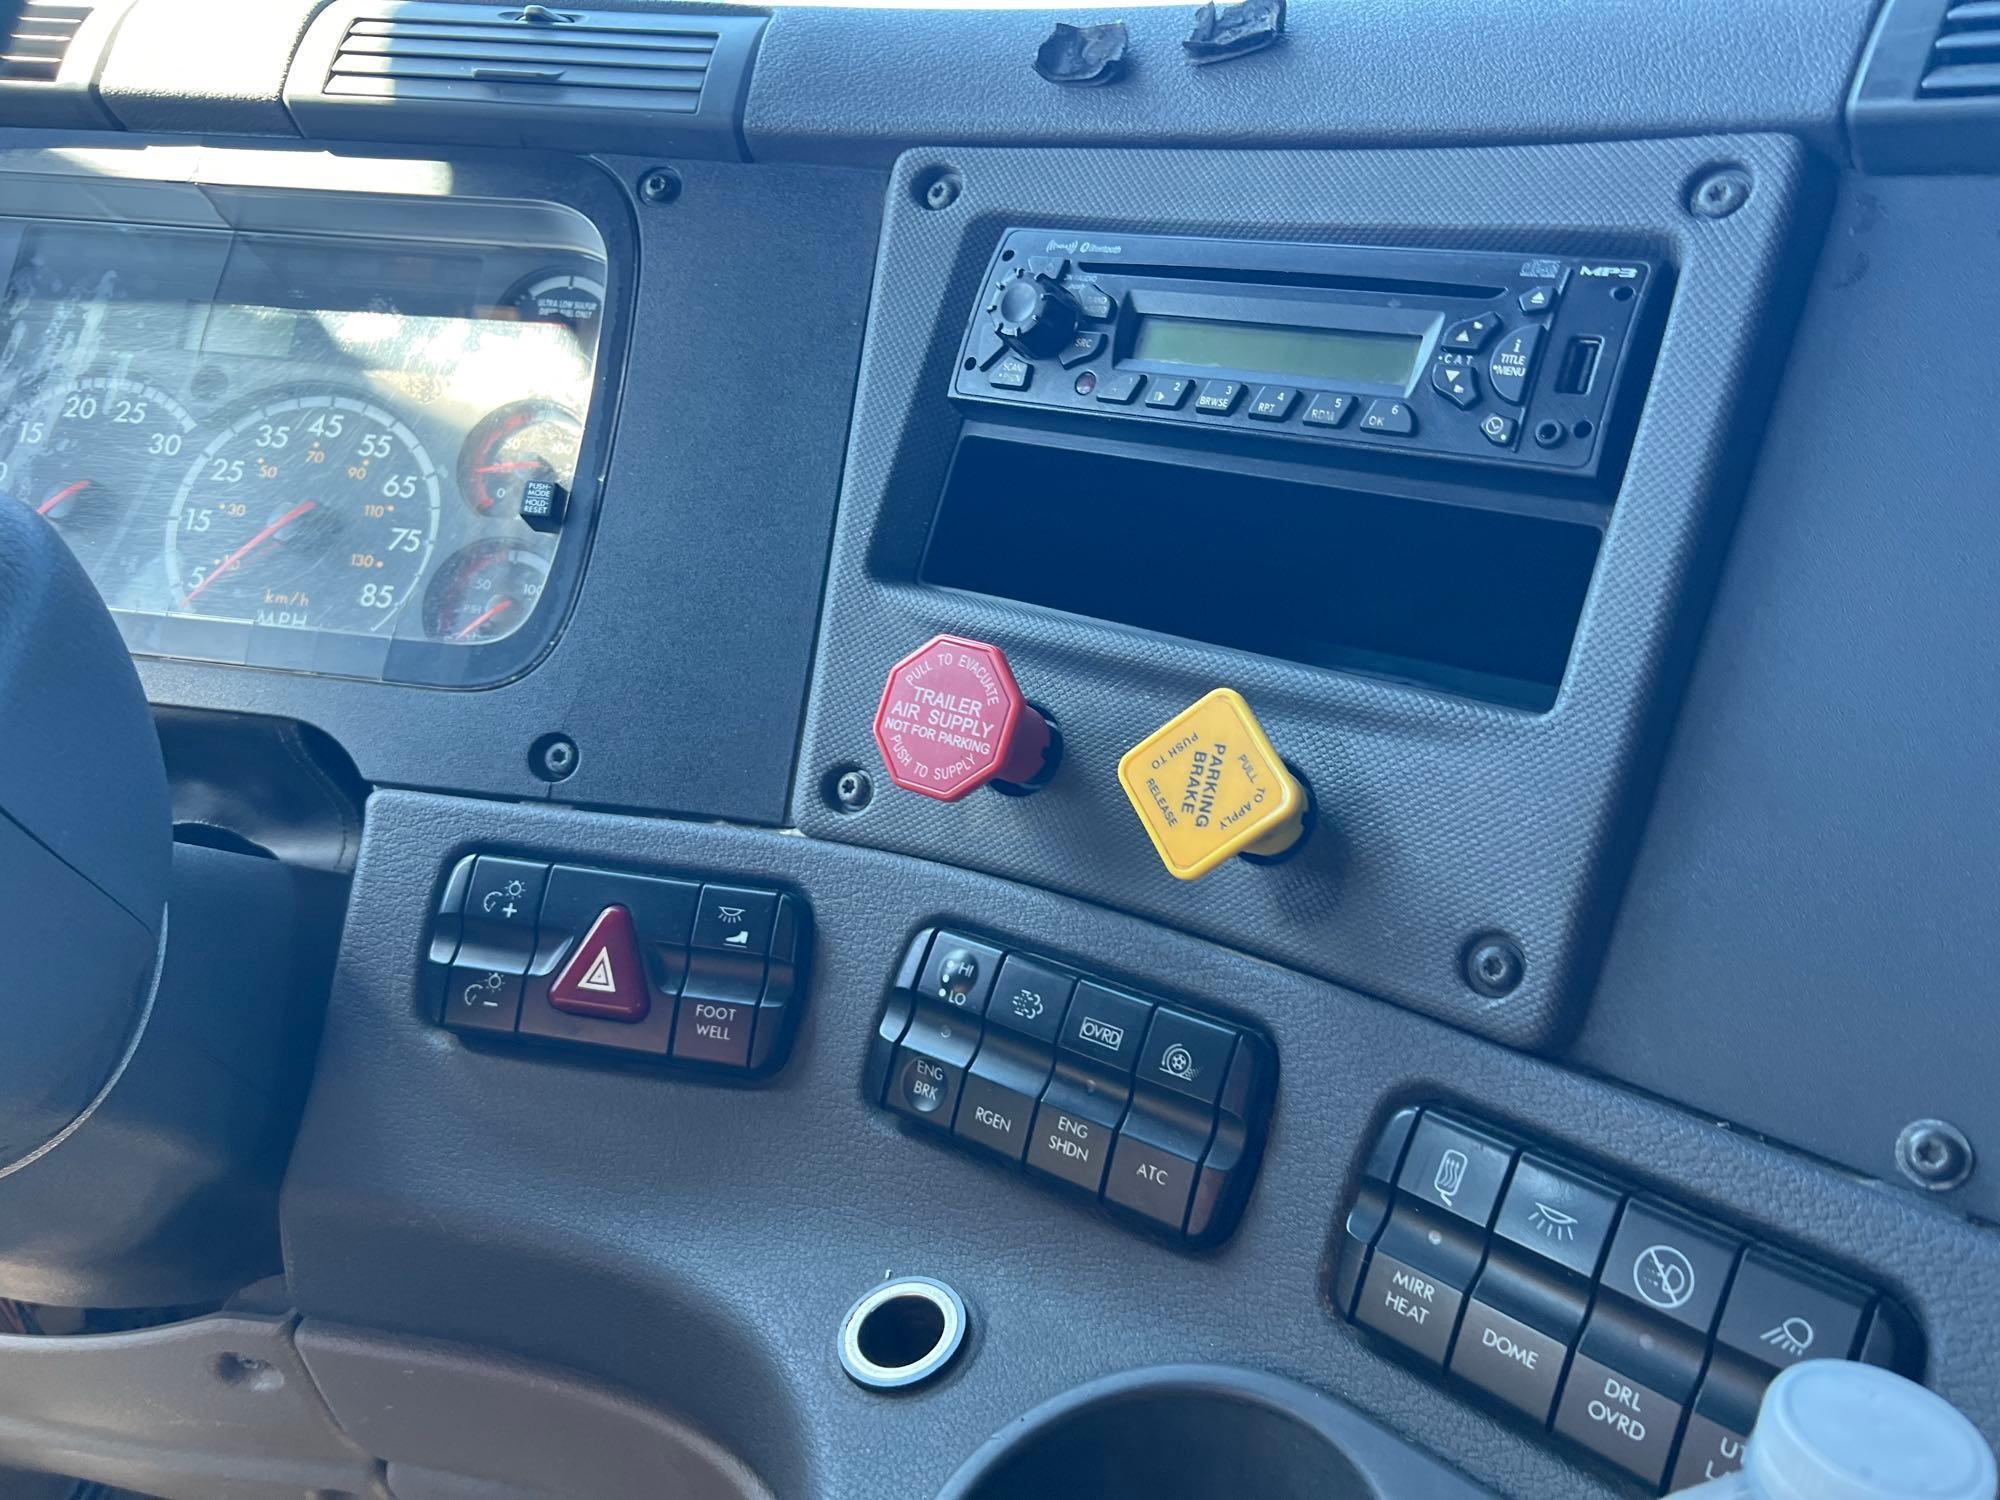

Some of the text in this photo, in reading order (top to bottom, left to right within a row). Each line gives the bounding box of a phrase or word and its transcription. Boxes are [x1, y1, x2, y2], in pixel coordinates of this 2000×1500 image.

[1580, 265, 1638, 278] MP3
[538, 299, 558, 308] ULTRA
[560, 300, 574, 309] LOW
[575, 310, 593, 318] ONLY
[1074, 338, 1092, 348] SRC
[1444, 354, 1474, 365] CAT
[1501, 354, 1526, 365] TITLE
[1496, 365, 1526, 377] MENU
[1174, 382, 1181, 392] 2
[1225, 386, 1232, 396] 3
[1277, 392, 1285, 401] 4
[63, 397, 97, 420] 20
[114, 401, 147, 424] 25
[1200, 396, 1229, 408] BRWSE
[1258, 402, 1276, 414] RPT
[1334, 398, 1343, 409] 5
[1391, 405, 1400, 416] 6
[308, 414, 345, 438] 45
[1369, 416, 1385, 426] OK
[19, 422, 44, 444] 15
[255, 425, 290, 448] 35
[150, 433, 182, 456] 30
[358, 434, 392, 458] 55
[306, 452, 325, 464] 70
[211, 459, 245, 482] 25
[258, 464, 278, 478] 50
[348, 468, 367, 480] 90
[383, 475, 418, 498] 65
[496, 488, 506, 498] 0
[528, 489, 550, 498] MODE
[185, 508, 212, 532] 15
[227, 504, 246, 516] 30
[364, 505, 384, 518] 110
[524, 506, 548, 514] RESET
[389, 528, 422, 552] 75
[352, 554, 374, 568] 130
[188, 566, 207, 589] 5
[264, 588, 310, 607] km/h
[360, 584, 394, 608] 85
[257, 609, 308, 626] MPH
[904, 652, 1000, 707] PULL TO EVACUATE
[914, 685, 982, 718] TRAILER
[891, 700, 995, 739] AIR SUPPLY
[885, 716, 990, 755] NOT FOR PARKING
[890, 734, 976, 781] PUSH TO SUPPLY
[1152, 731, 1200, 770] PUSH TO
[1181, 751, 1207, 815] BRAKE
[1194, 743, 1228, 828] PARKING
[1220, 754, 1266, 831] PULL TO APPLY
[1146, 778, 1179, 828] RELEASE
[958, 963, 974, 978] HI
[948, 989, 966, 1006] LO
[696, 1004, 737, 1022] FOOT
[696, 1022, 731, 1041] WELL
[1082, 1022, 1122, 1046] OVRD
[916, 1060, 944, 1082] ENG
[913, 1082, 940, 1102] BRK
[974, 1106, 1012, 1133] RGEN
[1057, 1116, 1090, 1140] ENG
[1048, 1135, 1090, 1163] SHDN
[1136, 1163, 1169, 1187] ATC
[1392, 1270, 1435, 1303] MIRR
[1384, 1291, 1431, 1326] HEAT
[1482, 1327, 1539, 1371] DOME
[1604, 1376, 1642, 1413] DRL
[1586, 1400, 1646, 1442] OVRD
